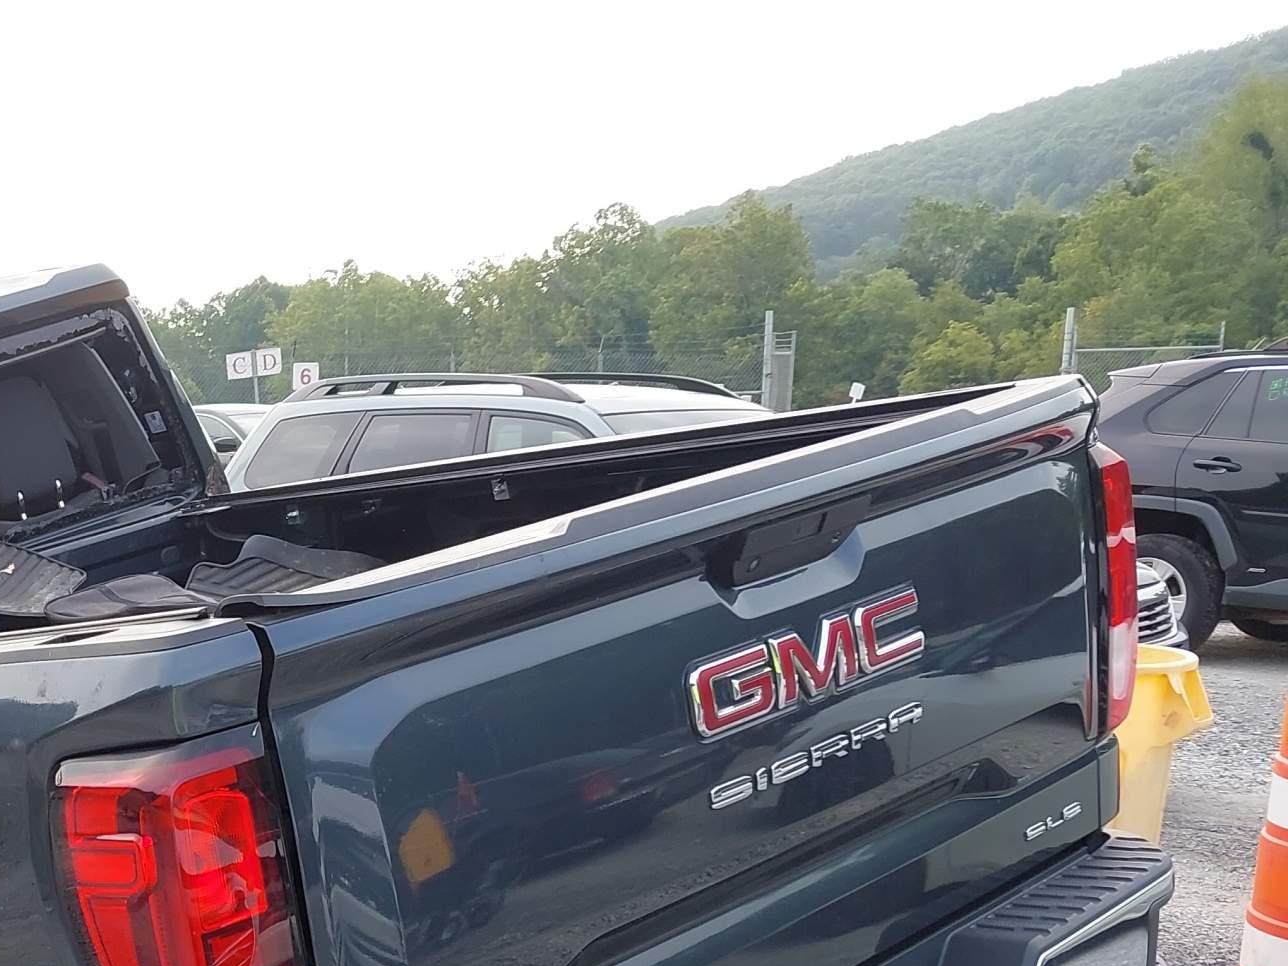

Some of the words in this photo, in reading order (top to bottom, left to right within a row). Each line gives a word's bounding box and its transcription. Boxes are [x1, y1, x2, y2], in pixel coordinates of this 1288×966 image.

[232, 356, 247, 375] C
[262, 353, 277, 371] D
[300, 368, 312, 385] 6
[686, 584, 925, 740] GMC
[710, 700, 923, 810] SIERRA
[1024, 800, 1082, 841] SLE
